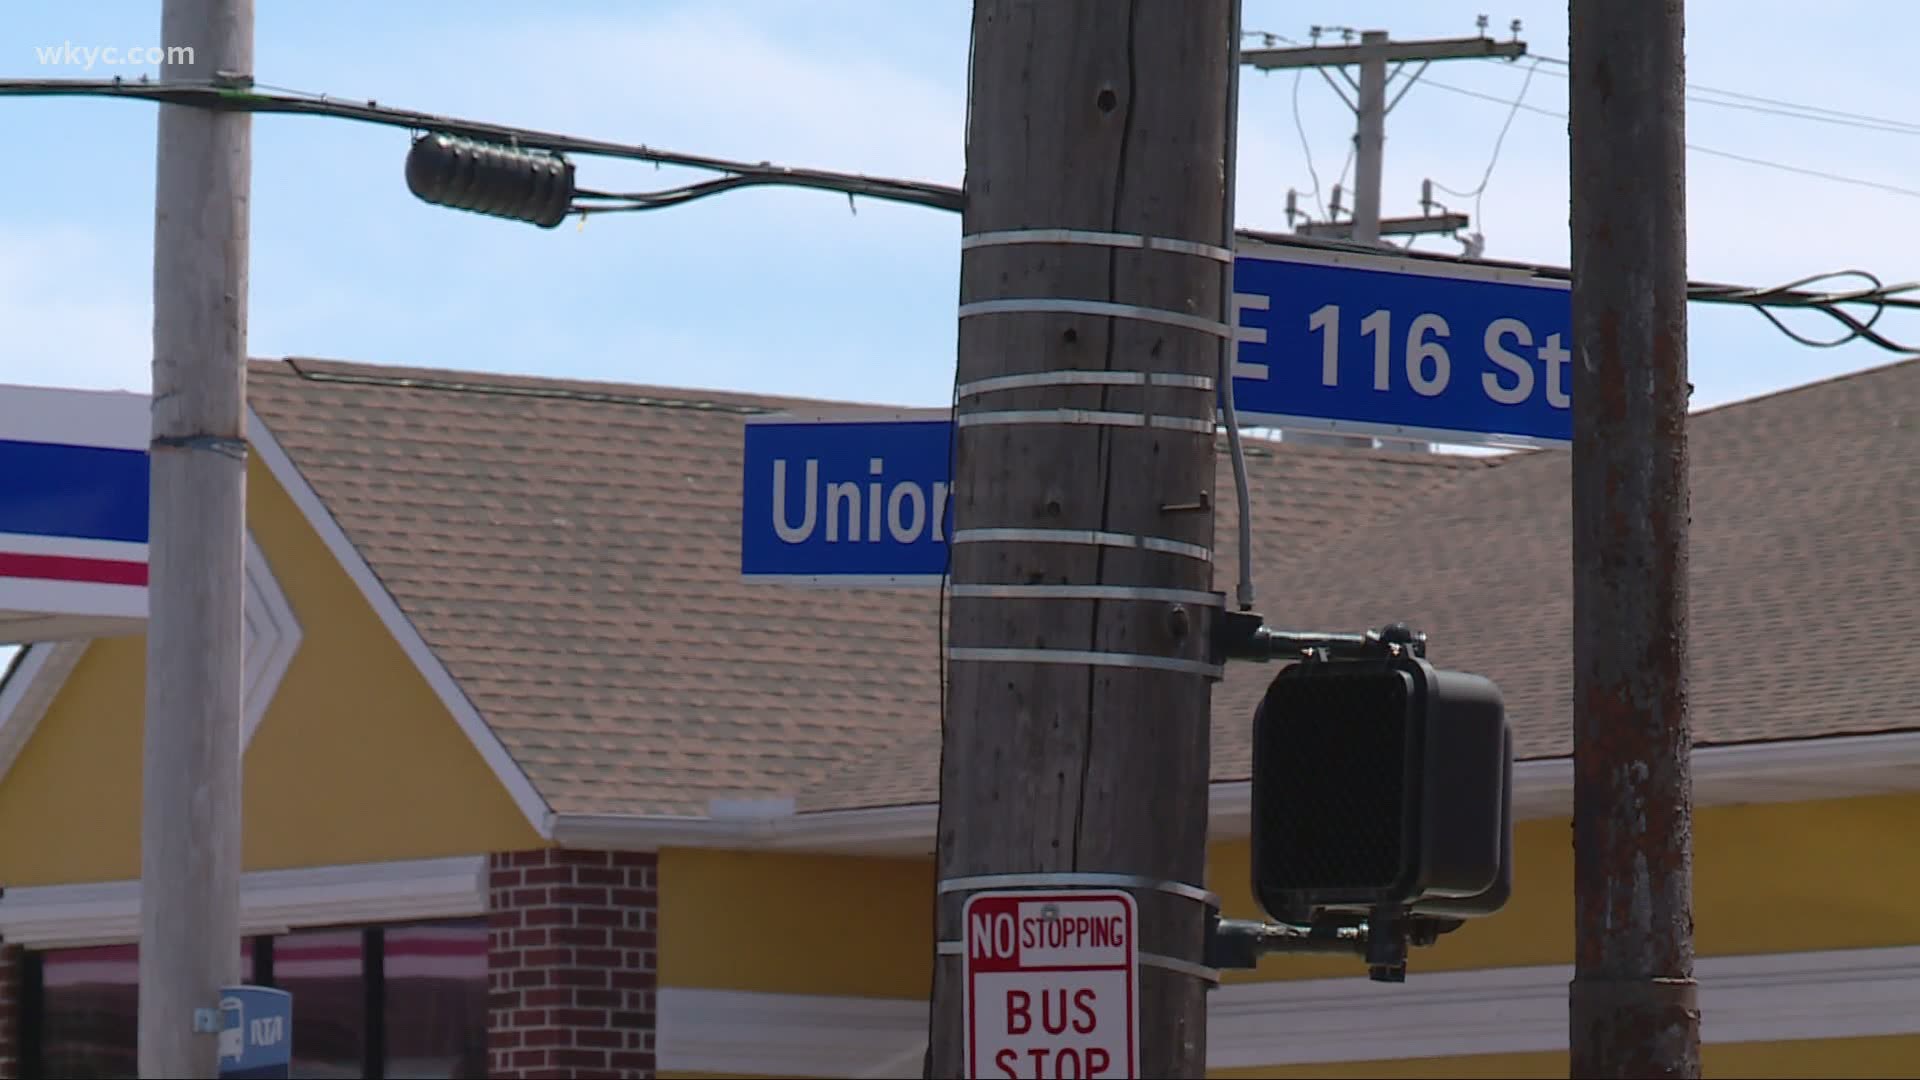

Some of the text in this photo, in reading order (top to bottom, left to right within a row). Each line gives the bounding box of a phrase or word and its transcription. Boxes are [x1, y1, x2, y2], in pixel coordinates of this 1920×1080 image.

[1231, 293, 1572, 409] E 116 St
[971, 912, 1124, 960] NO STOPPING
[1006, 988, 1097, 1036] BUS
[994, 1047, 1111, 1079] STOP
